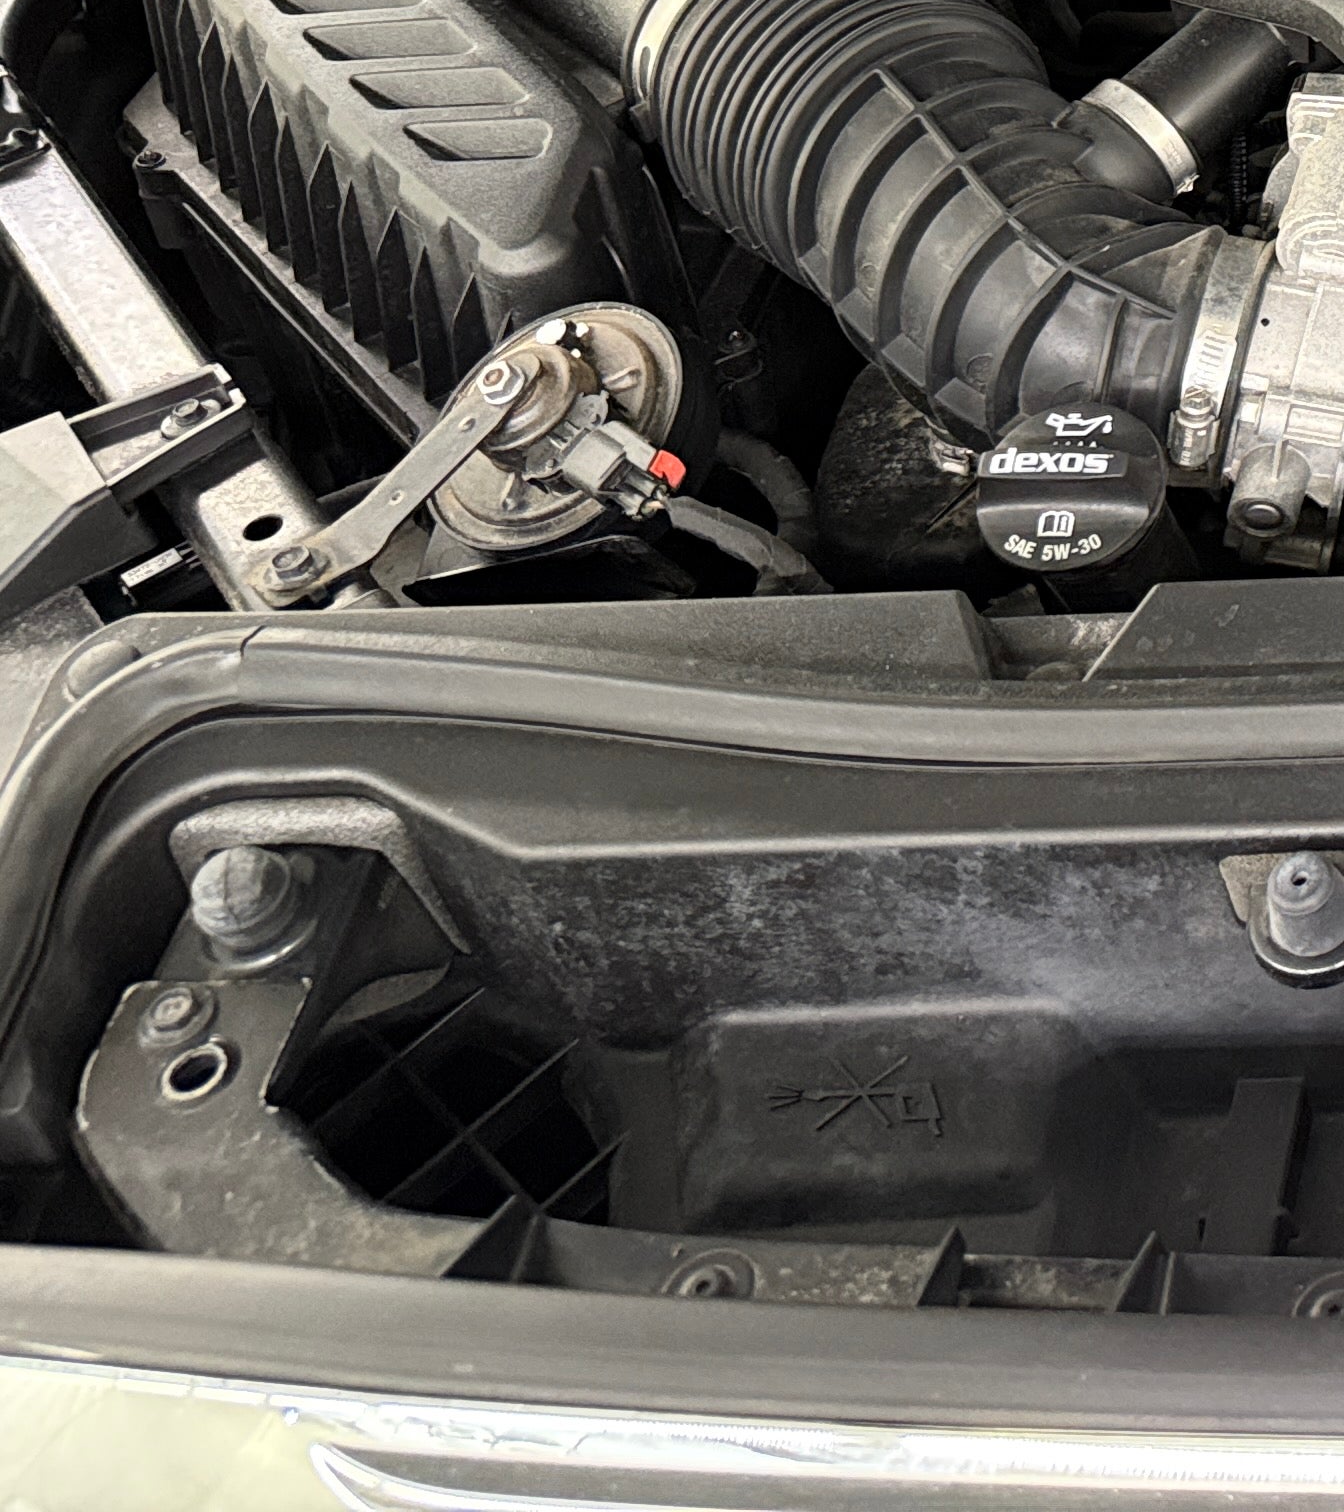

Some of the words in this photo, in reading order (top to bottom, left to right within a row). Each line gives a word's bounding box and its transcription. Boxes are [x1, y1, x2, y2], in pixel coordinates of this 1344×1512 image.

[989, 447, 1109, 474] dexos
[1003, 534, 1037, 559] SAE
[1041, 533, 1102, 561] 5W-30
